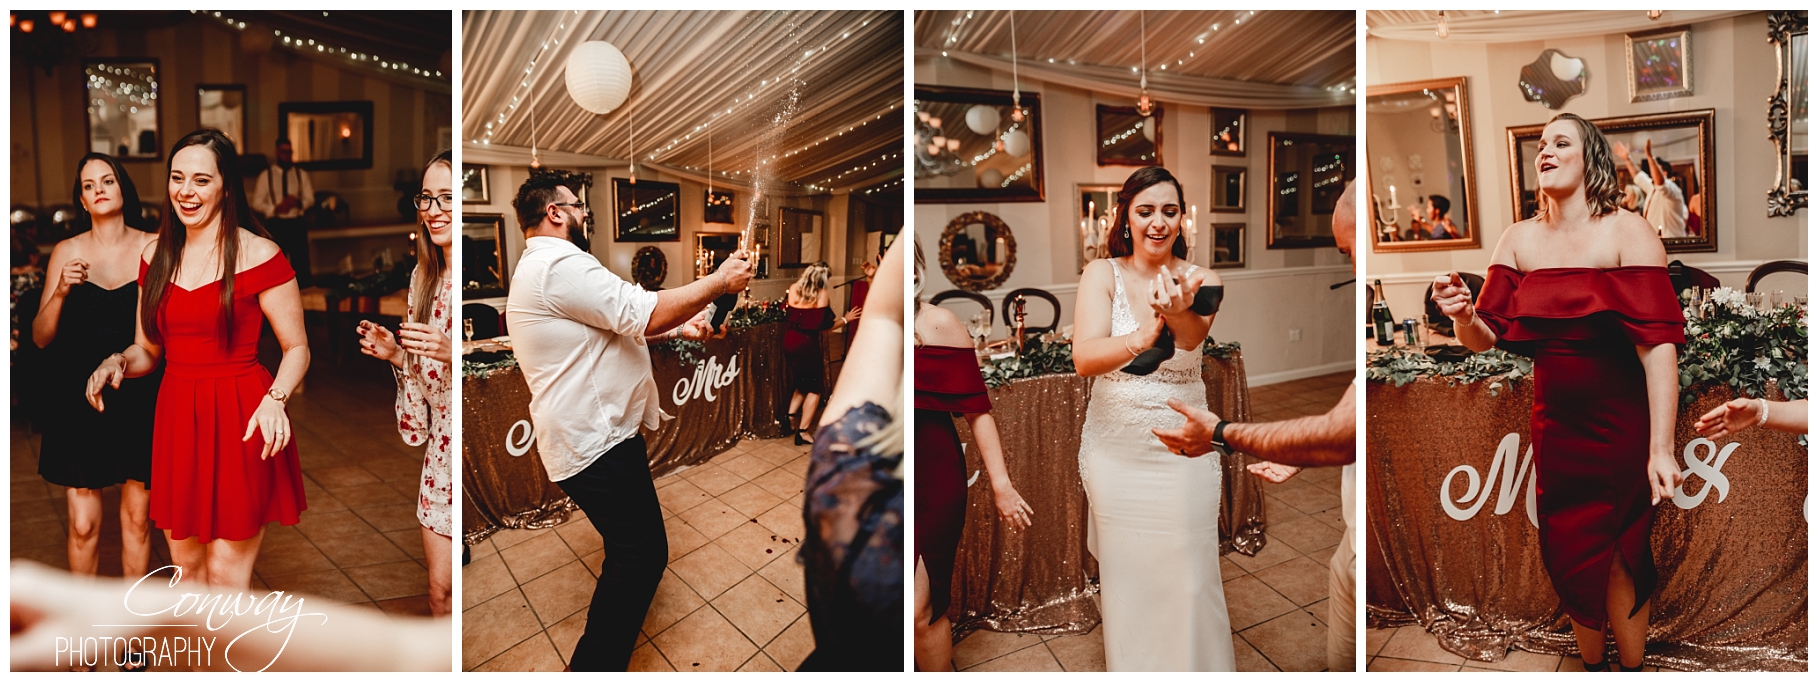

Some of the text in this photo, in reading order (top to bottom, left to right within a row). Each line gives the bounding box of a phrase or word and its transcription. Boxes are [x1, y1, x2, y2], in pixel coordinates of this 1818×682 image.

[672, 354, 740, 406] Mrs
[1440, 433, 1741, 529] M &
